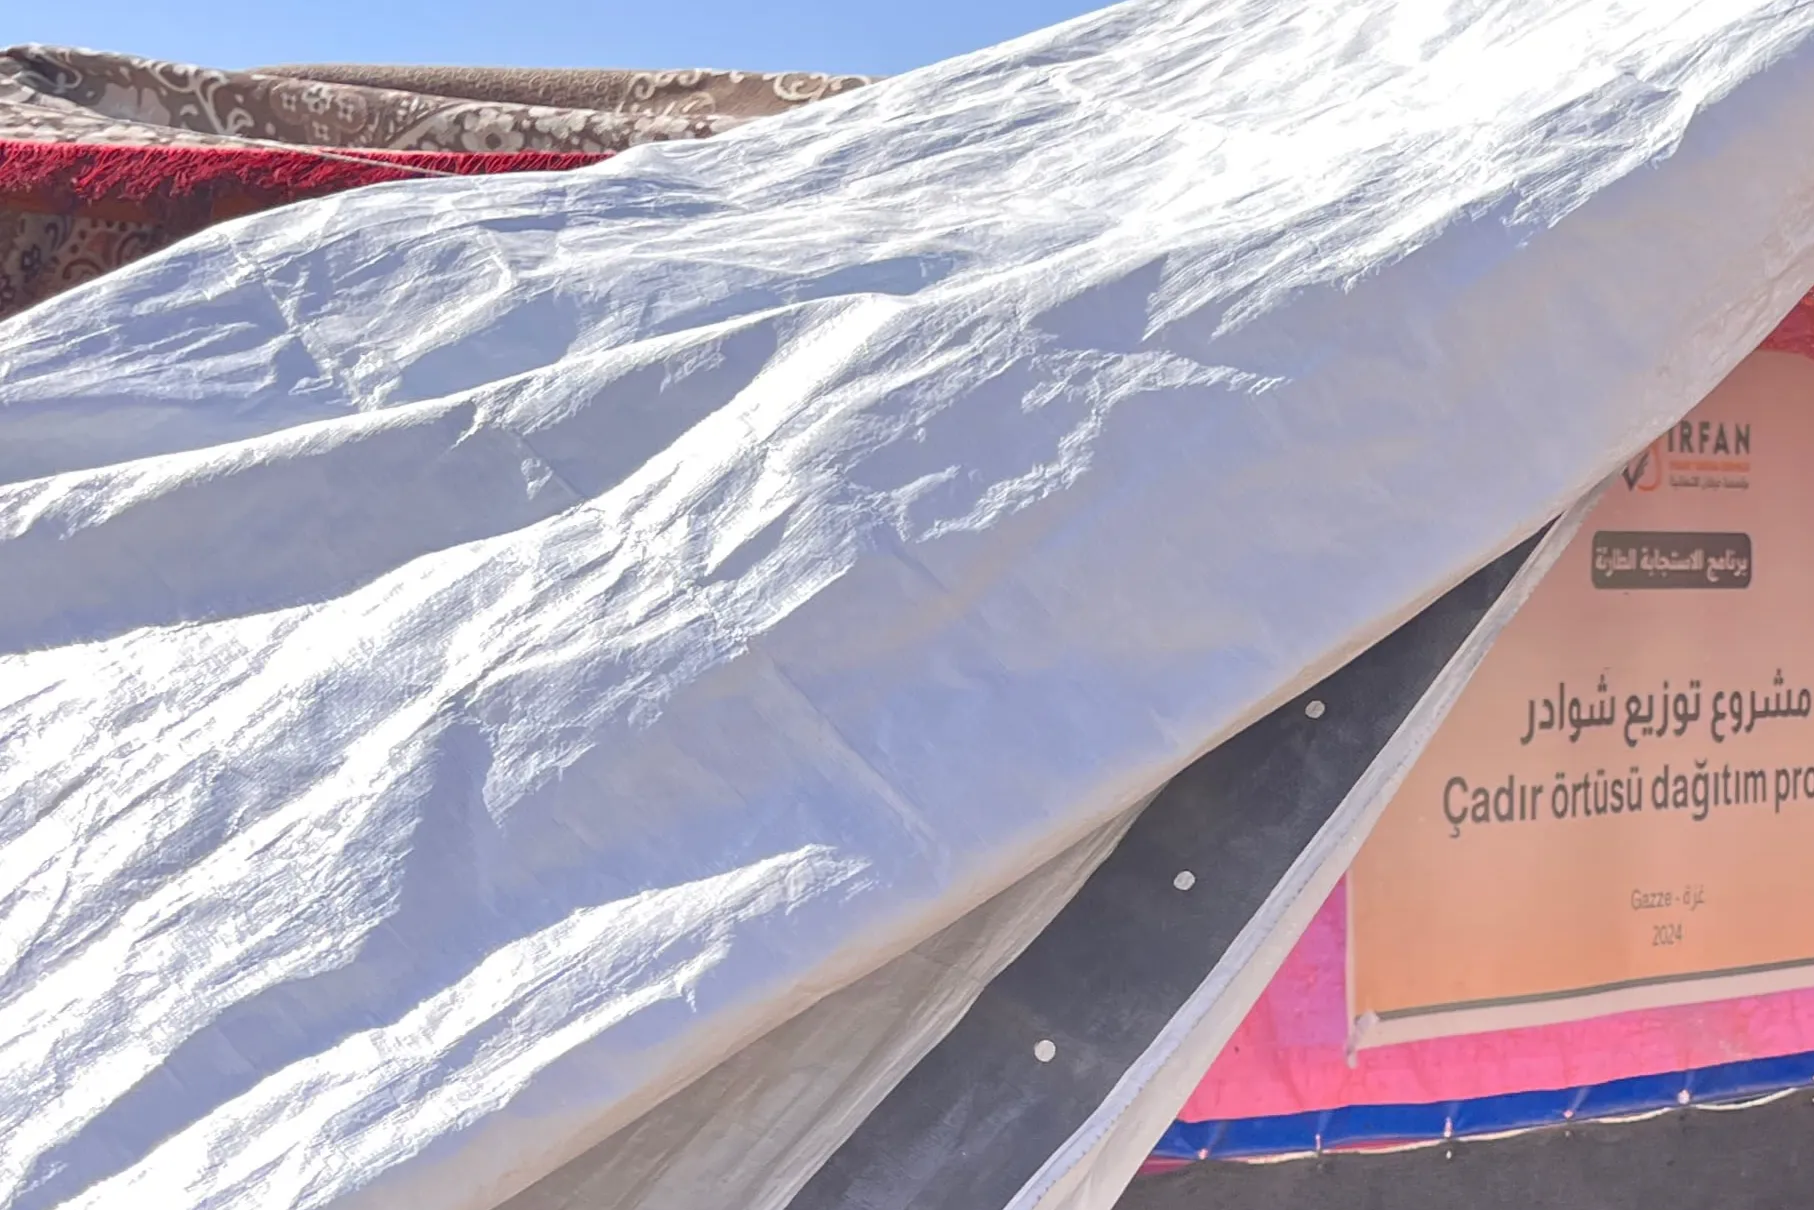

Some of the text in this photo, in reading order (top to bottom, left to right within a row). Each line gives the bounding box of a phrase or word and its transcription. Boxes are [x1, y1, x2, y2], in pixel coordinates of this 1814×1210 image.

[1667, 420, 1751, 455] IRFAN
[1640, 546, 1704, 577] الاستجابة
[1706, 549, 1748, 582] برنامج
[1520, 668, 1812, 747] مشروع توزيع شوادر
[1442, 774, 1544, 839] Çadır
[1550, 766, 1644, 820] örtüsü
[1650, 758, 1768, 822] dağıtım
[1630, 888, 1673, 911] Gazze
[1652, 923, 1684, 946] 2024
